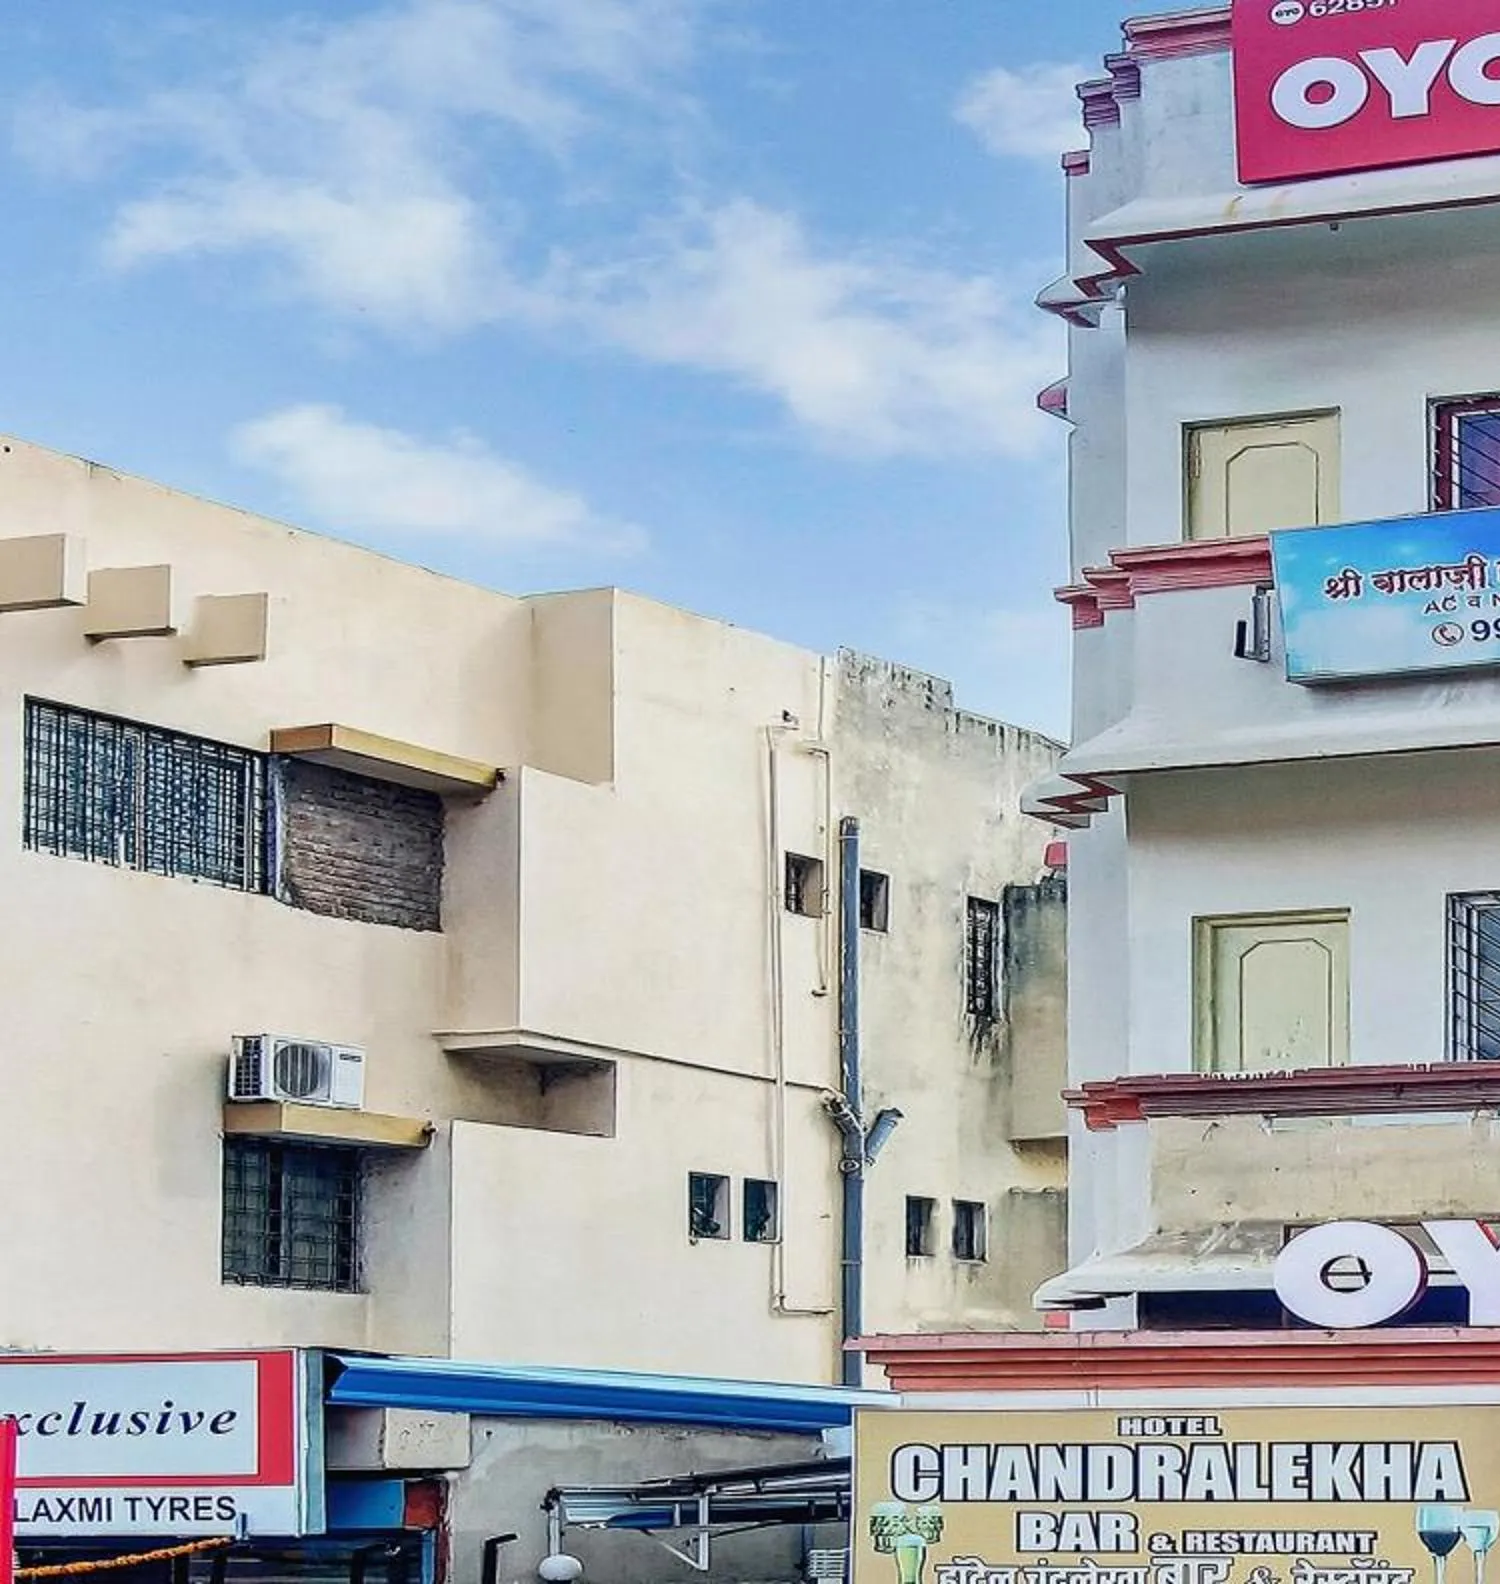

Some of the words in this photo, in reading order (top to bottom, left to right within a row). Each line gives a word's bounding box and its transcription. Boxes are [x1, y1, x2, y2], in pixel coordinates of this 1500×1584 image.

[1324, 566, 1363, 600] श्री
[1372, 554, 1489, 595] बालाजी
[1424, 597, 1458, 614] AC
[1117, 1415, 1223, 1437] HOTEL
[890, 1441, 1471, 1503] CHANDRALEKHA
[14, 1496, 113, 1523] LAXMI
[124, 1495, 238, 1522] TYRES
[1016, 1511, 1140, 1553] BAR
[1149, 1532, 1178, 1554] &
[1182, 1530, 1379, 1555] RESTAURANT
